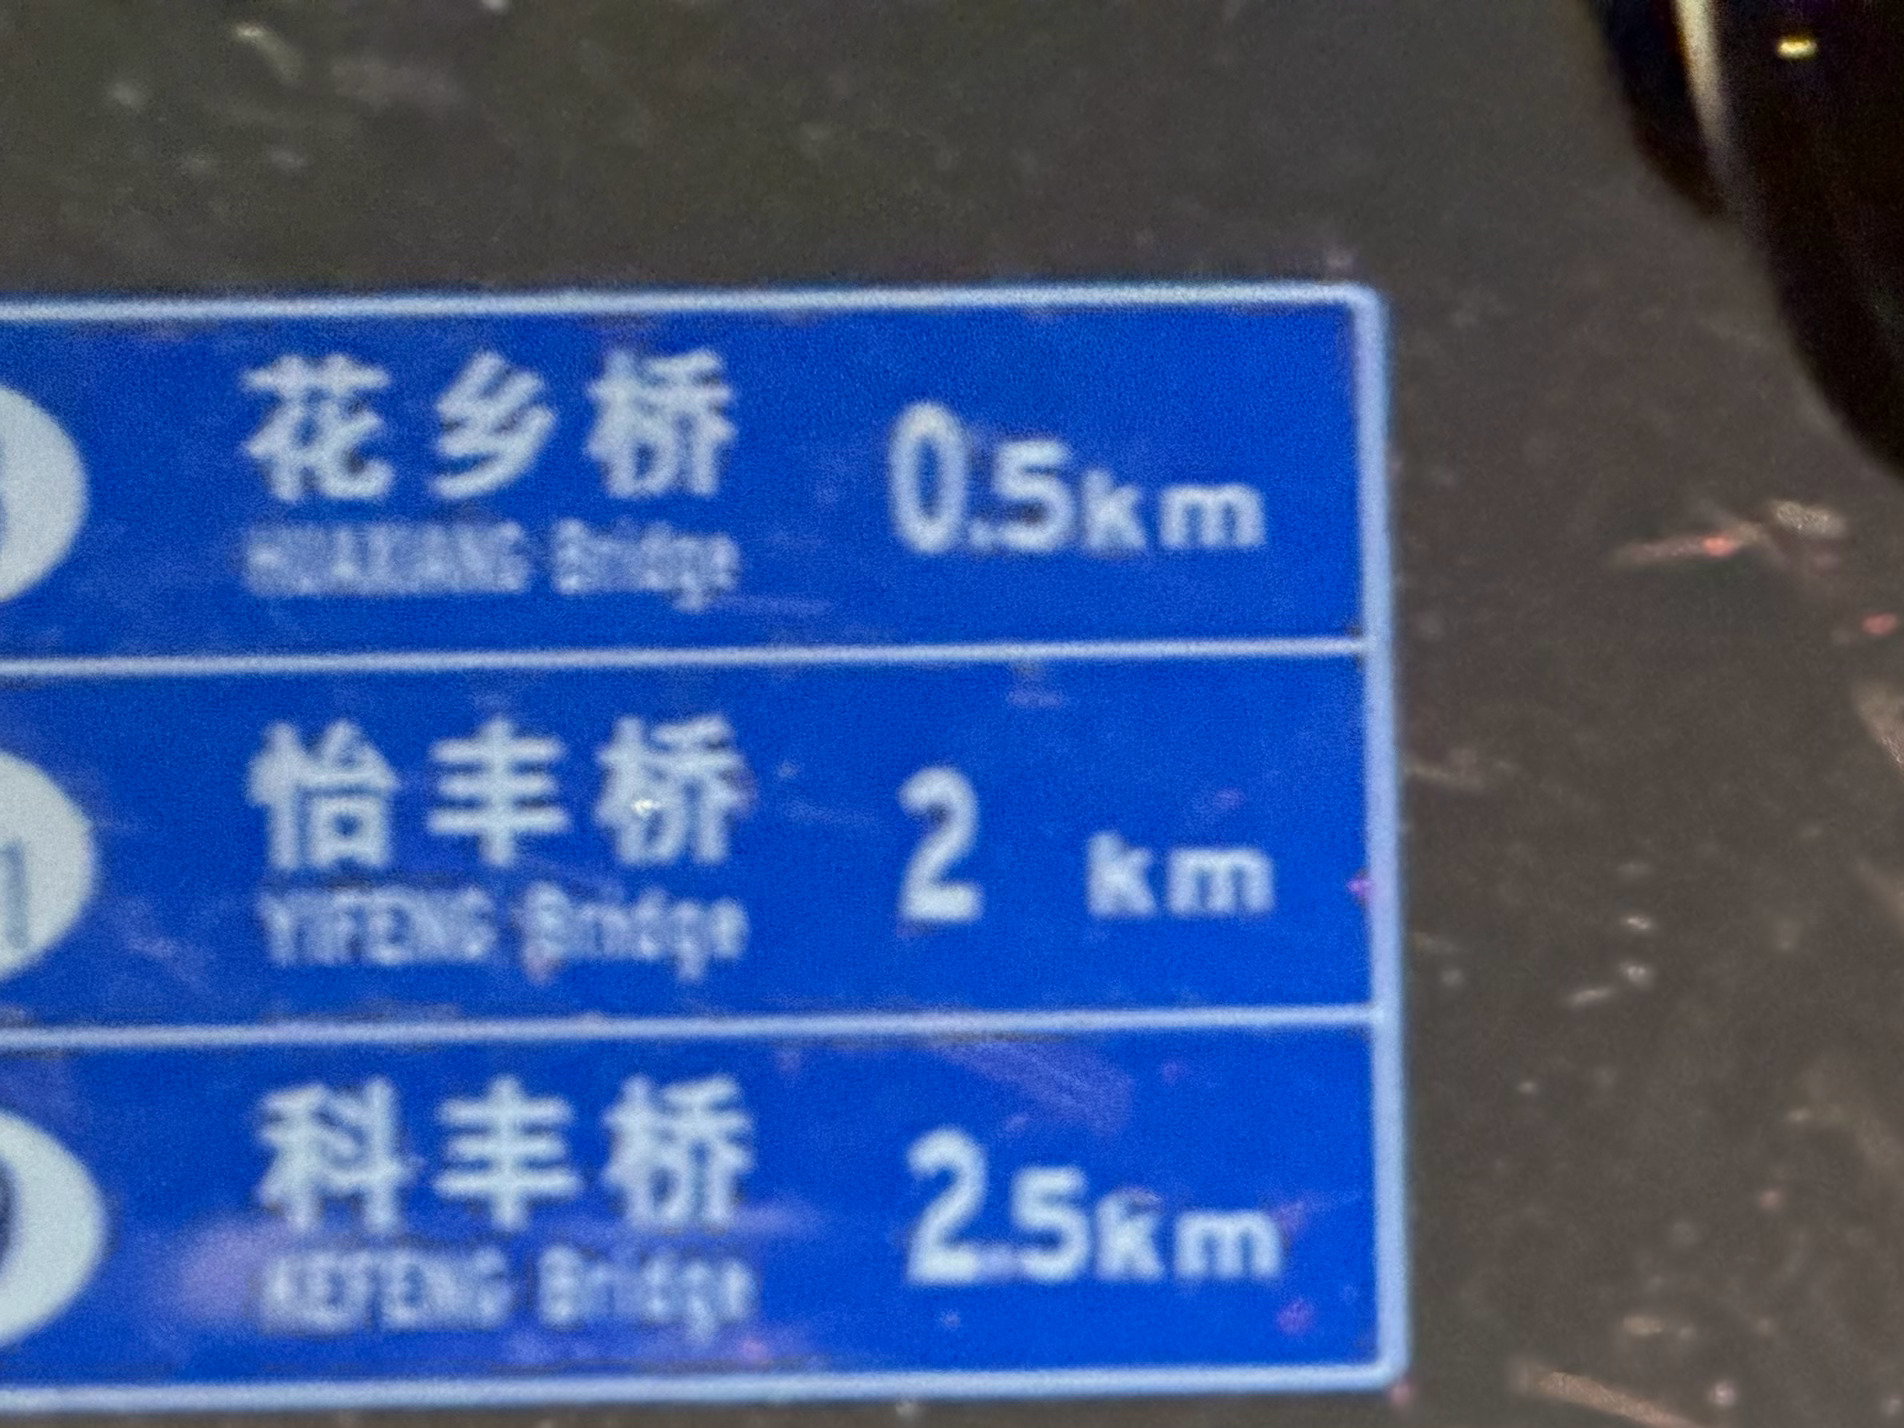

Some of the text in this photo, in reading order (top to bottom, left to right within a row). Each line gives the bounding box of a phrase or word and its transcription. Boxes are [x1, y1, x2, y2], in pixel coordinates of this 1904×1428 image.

[243, 349, 737, 500] 花乡桥
[552, 518, 741, 612] Bridge
[248, 713, 745, 867] 怡丰桥
[901, 767, 1273, 923] 2 km
[524, 880, 750, 981] Bridge
[257, 1073, 755, 1232] 科丰桥
[537, 1244, 756, 1346] Bridge
